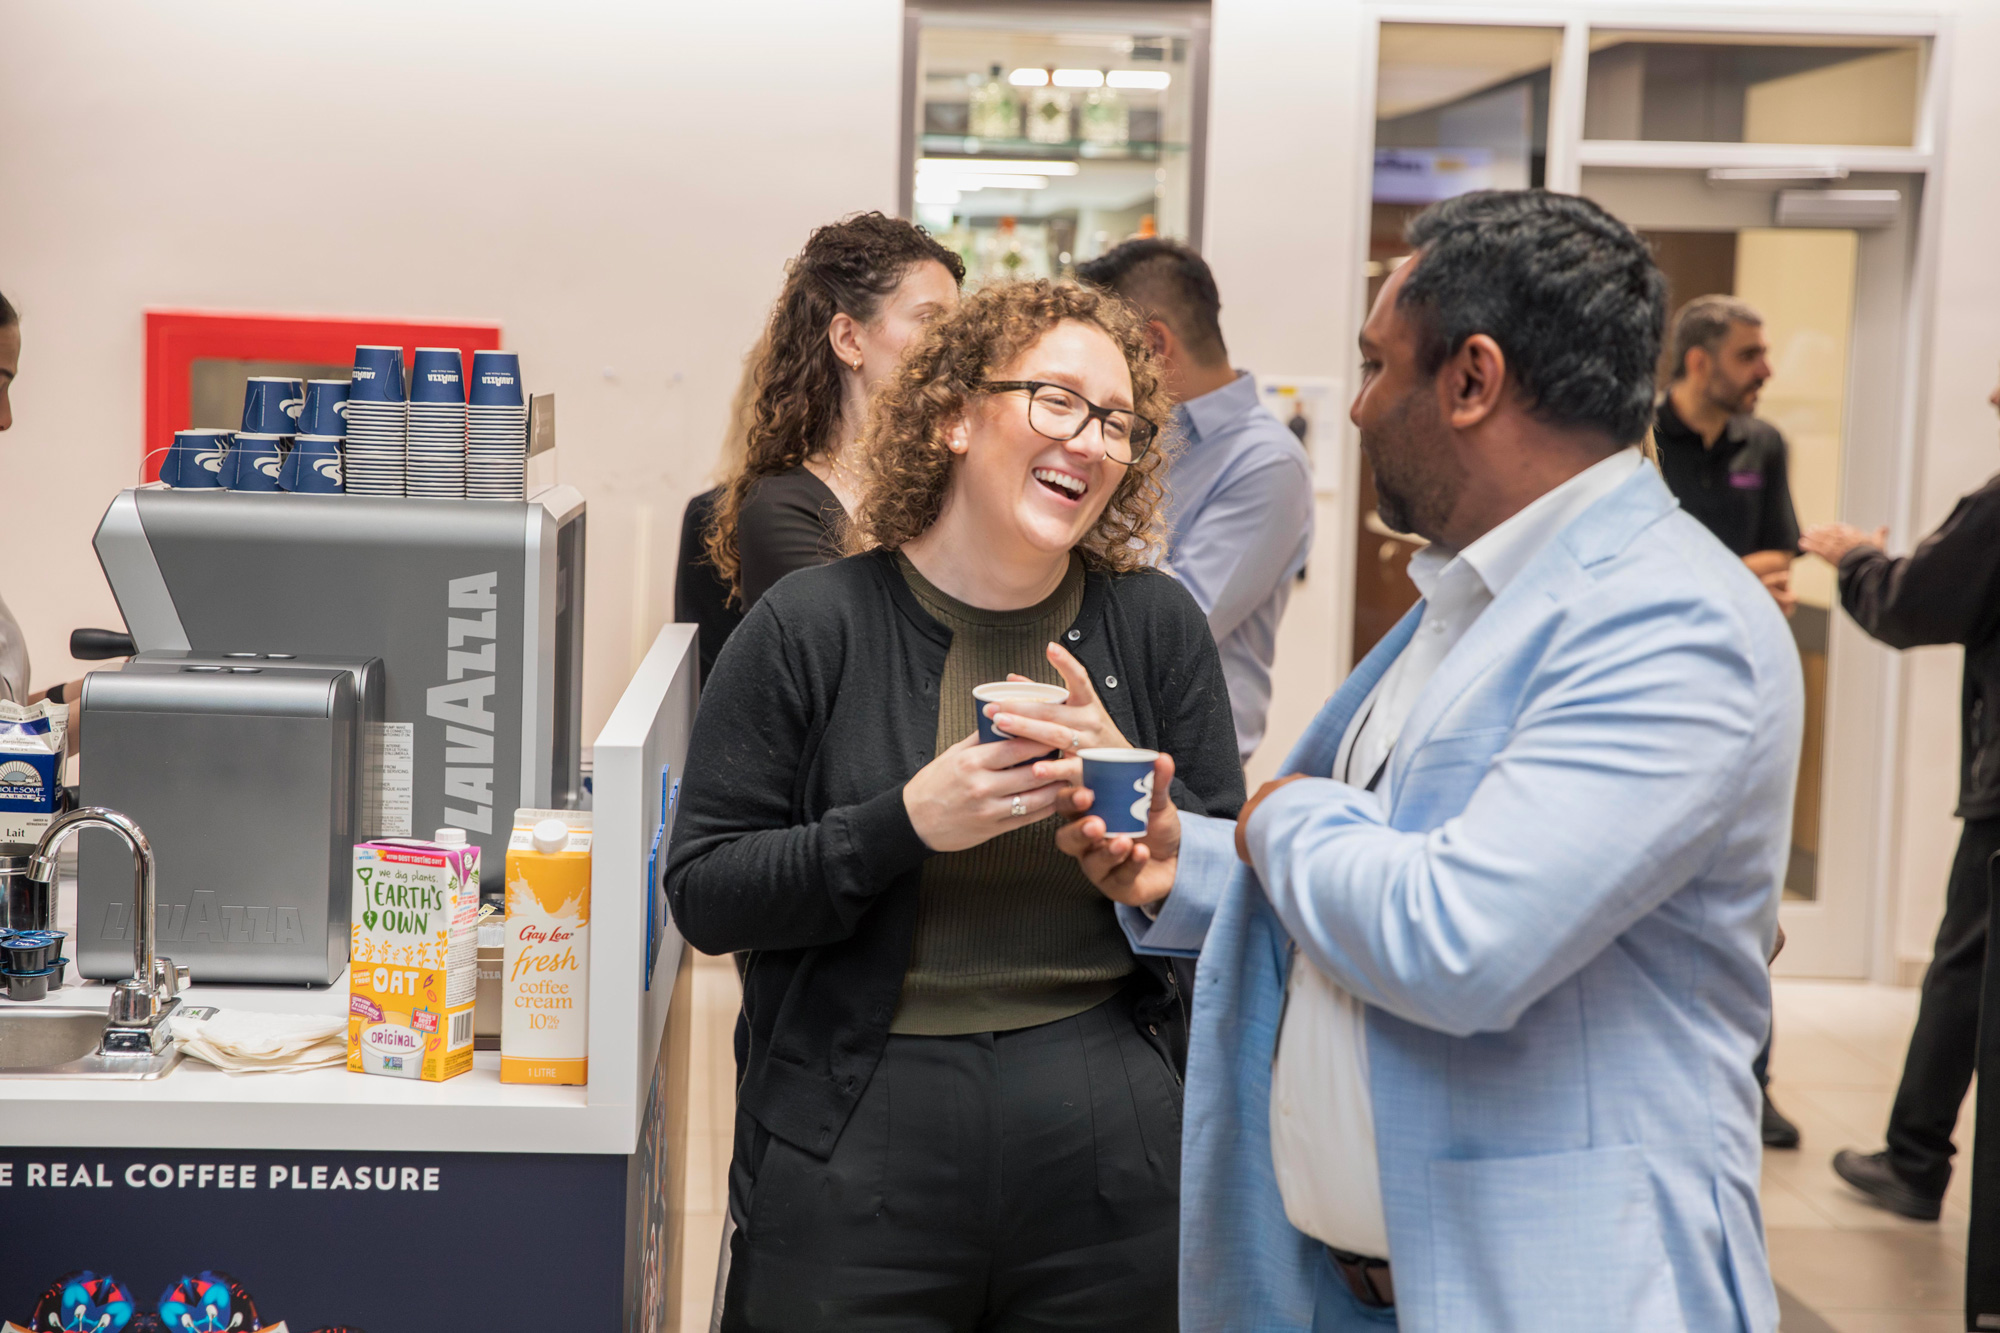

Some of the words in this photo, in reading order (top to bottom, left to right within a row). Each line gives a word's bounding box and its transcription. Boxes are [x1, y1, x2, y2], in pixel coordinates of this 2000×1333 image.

[428, 373, 459, 385] LAVAZZA
[481, 376, 514, 387] LAVAZZA
[426, 571, 498, 835] LAVAZZA
[6, 828, 25, 837] Lait
[379, 870, 391, 878] we
[395, 870, 408, 883] dig
[411, 870, 438, 883] plants.
[374, 881, 443, 911] EARTH'S
[382, 910, 428, 935] OWN
[519, 925, 548, 943] Gay
[549, 926, 569, 942] Lea
[510, 945, 579, 982] fresh
[373, 967, 419, 996] OAT
[519, 980, 569, 994] coffee
[514, 995, 573, 1009] cream
[533, 1068, 557, 1078] LITRE
[27, 1163, 113, 1187] REAL
[124, 1163, 256, 1189] COFFEE
[269, 1165, 440, 1191] PLEASURE
